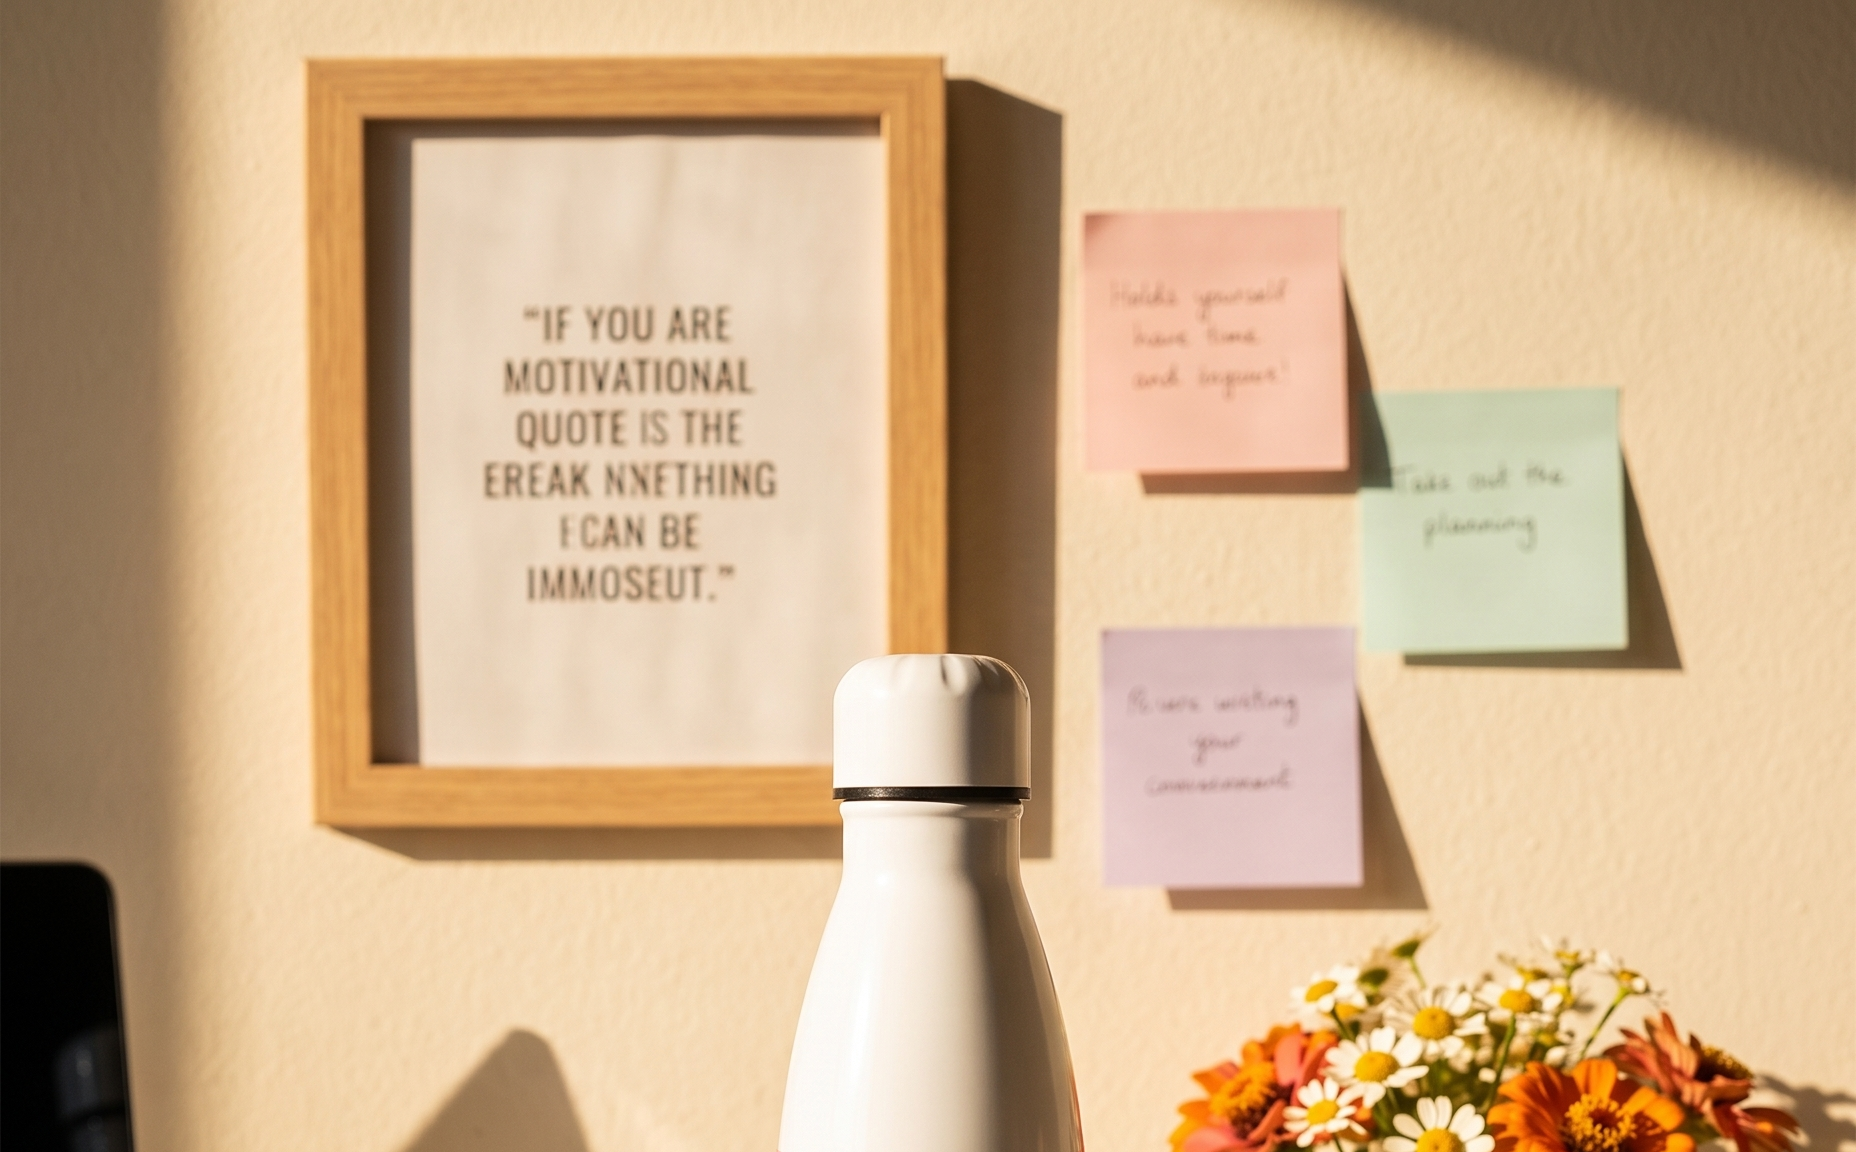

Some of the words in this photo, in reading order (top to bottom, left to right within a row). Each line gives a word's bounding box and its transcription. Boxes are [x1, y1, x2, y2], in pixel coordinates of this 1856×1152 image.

[585, 306, 655, 342] YOU
[668, 306, 732, 342] ARE
[504, 358, 755, 395] MOTIVATIONAL
[516, 410, 628, 450] QUOTE
[640, 410, 670, 446] IS
[681, 410, 743, 446] THE
[484, 462, 590, 498] EREAK
[580, 513, 645, 550] CAN
[660, 513, 700, 550] BE
